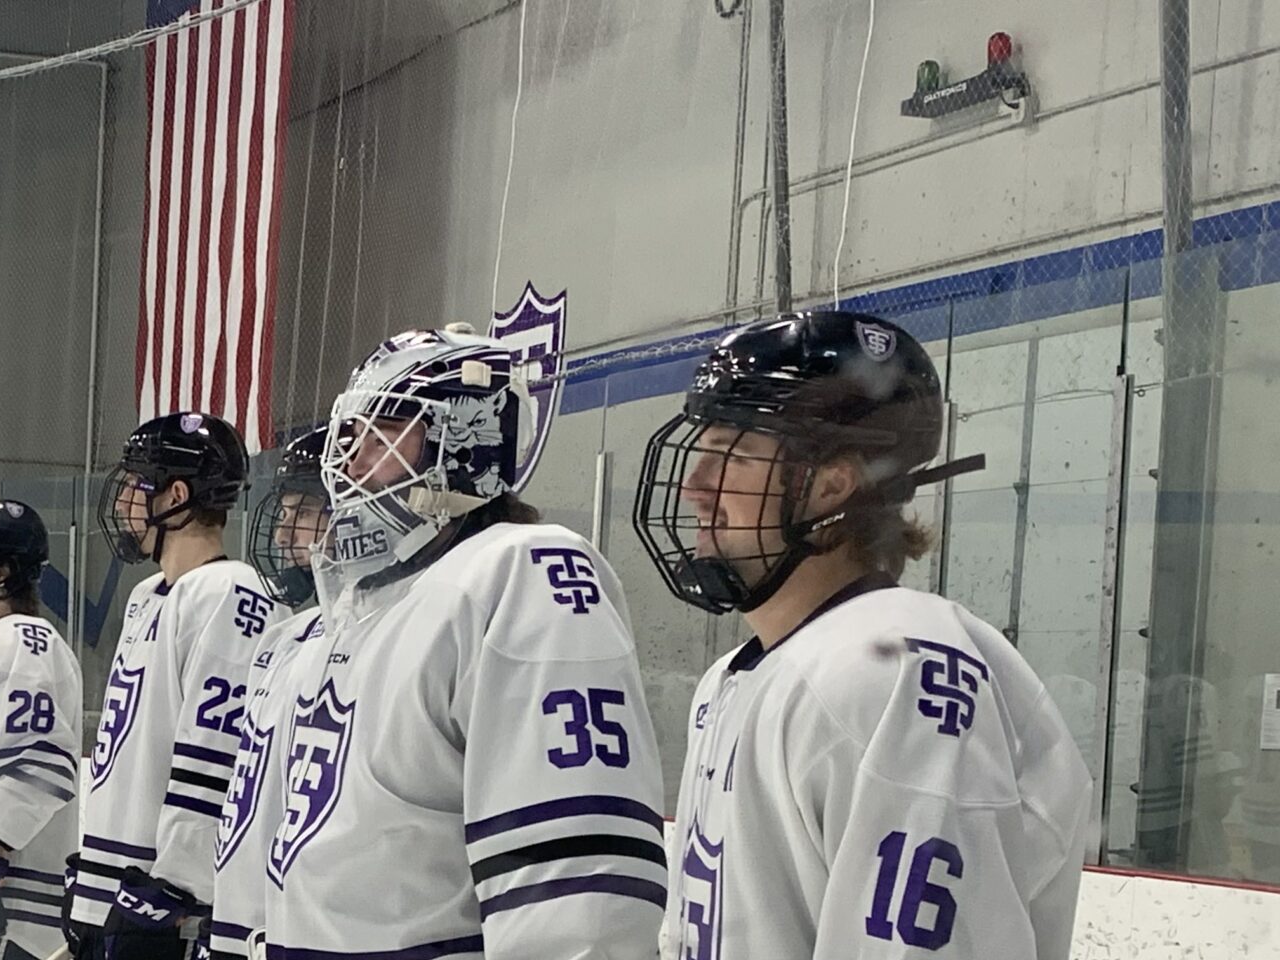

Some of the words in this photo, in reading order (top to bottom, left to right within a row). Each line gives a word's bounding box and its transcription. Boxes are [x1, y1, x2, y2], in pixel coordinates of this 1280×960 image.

[5, 690, 56, 734] 28
[541, 688, 631, 770] 35
[865, 831, 964, 952] 16
